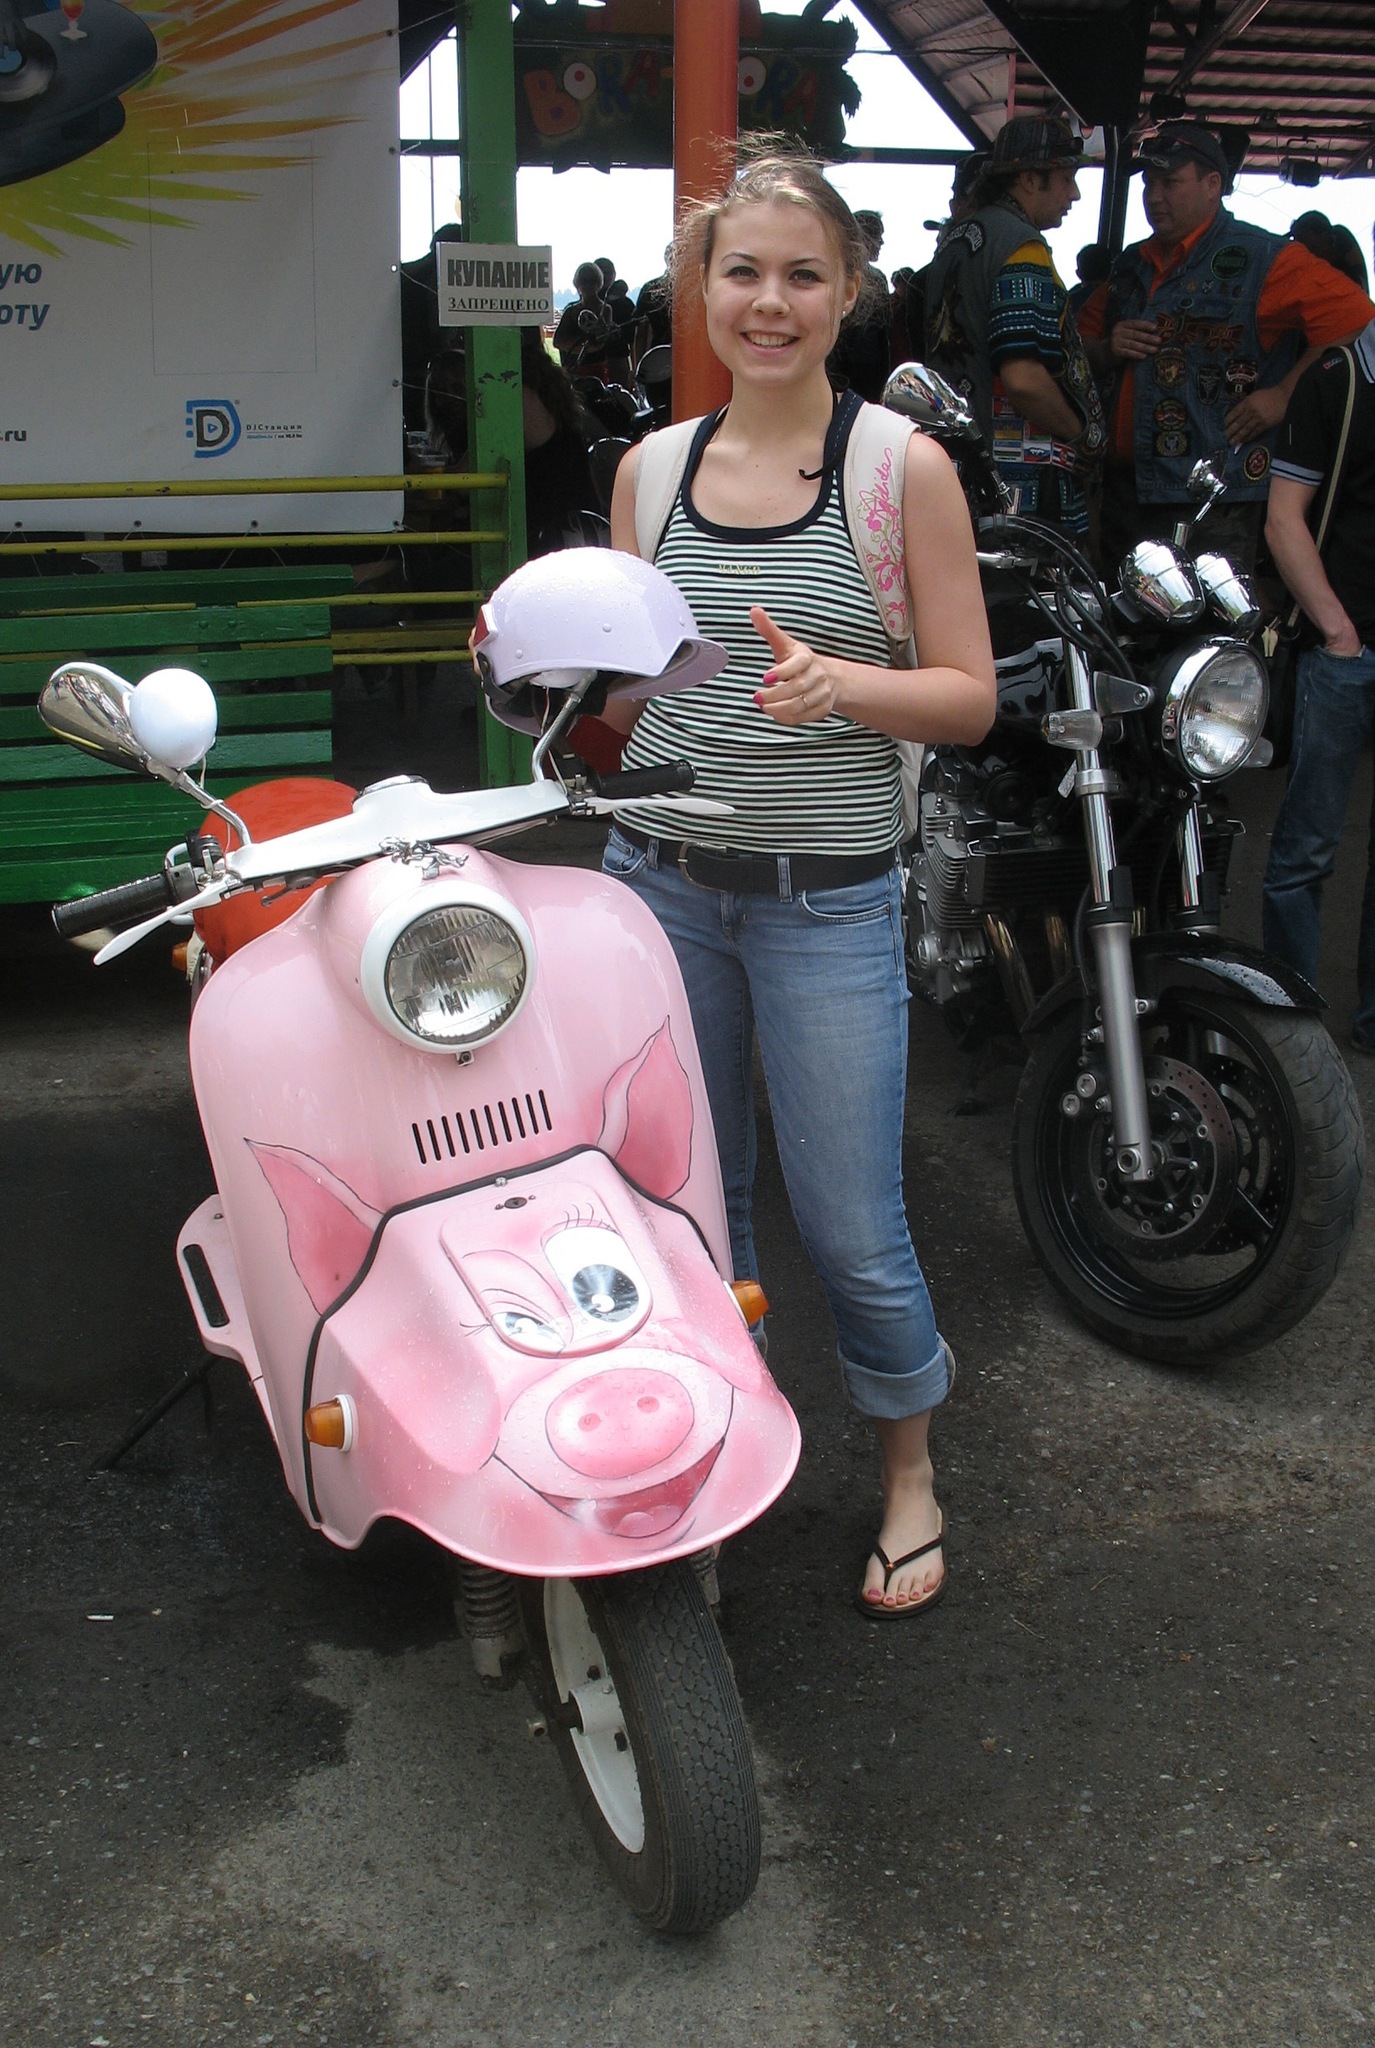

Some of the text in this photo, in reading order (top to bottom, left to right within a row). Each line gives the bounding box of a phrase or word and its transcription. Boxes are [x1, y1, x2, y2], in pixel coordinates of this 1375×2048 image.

[447, 259, 549, 288] КУПАНИЕ
[447, 297, 549, 313] ЗАПРЕЩЕНО
[0, 430, 27, 442] .ru
